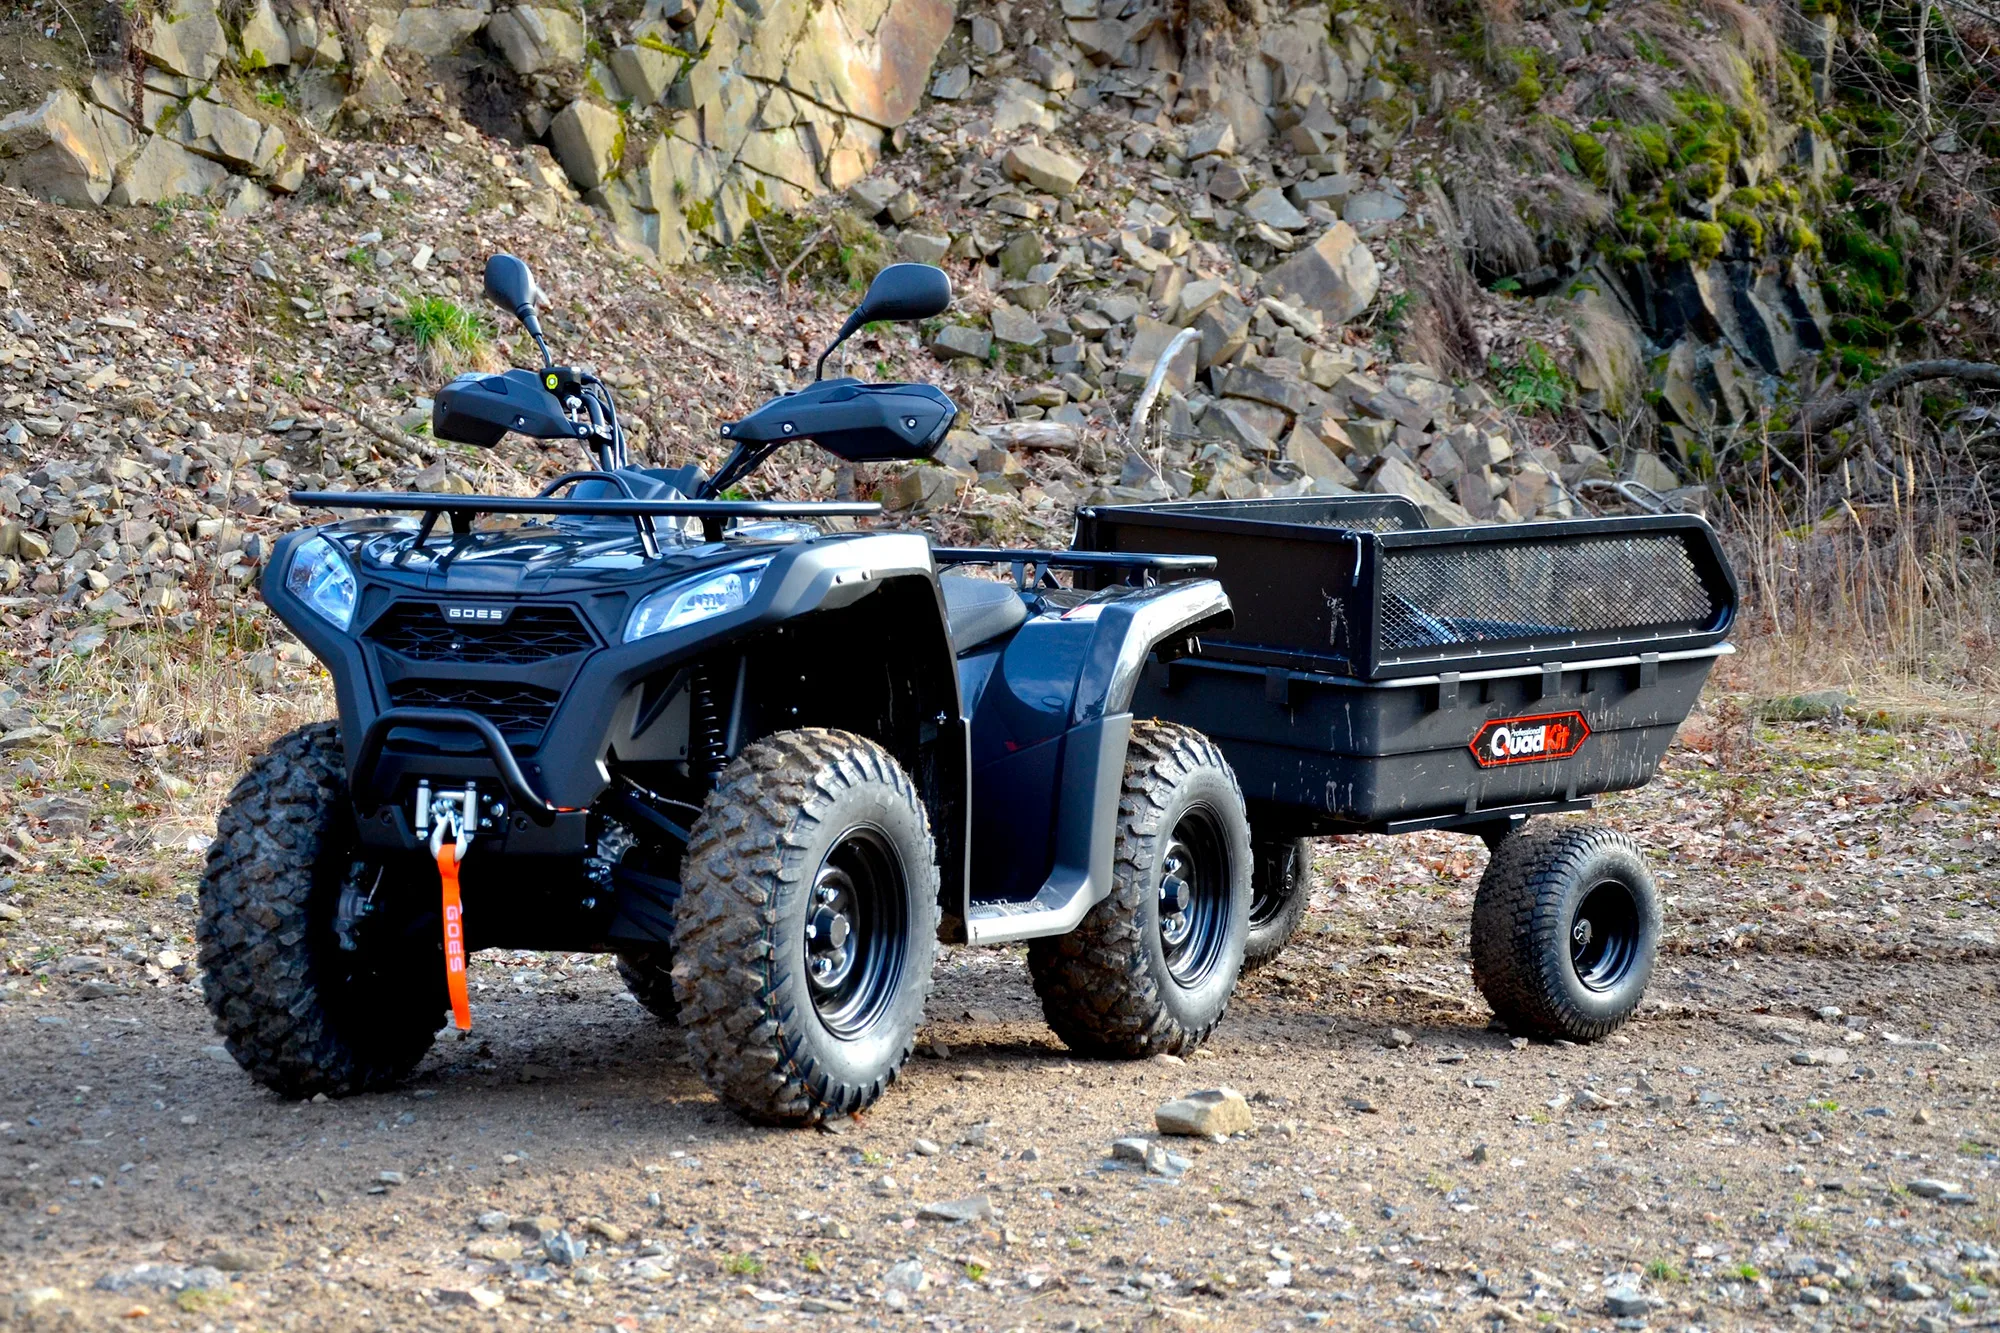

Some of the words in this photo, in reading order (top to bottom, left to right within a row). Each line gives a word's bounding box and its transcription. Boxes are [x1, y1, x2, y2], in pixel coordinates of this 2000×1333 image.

[449, 608, 503, 619] GOES
[1511, 726, 1542, 737] Professional
[446, 905, 463, 973] GOES
